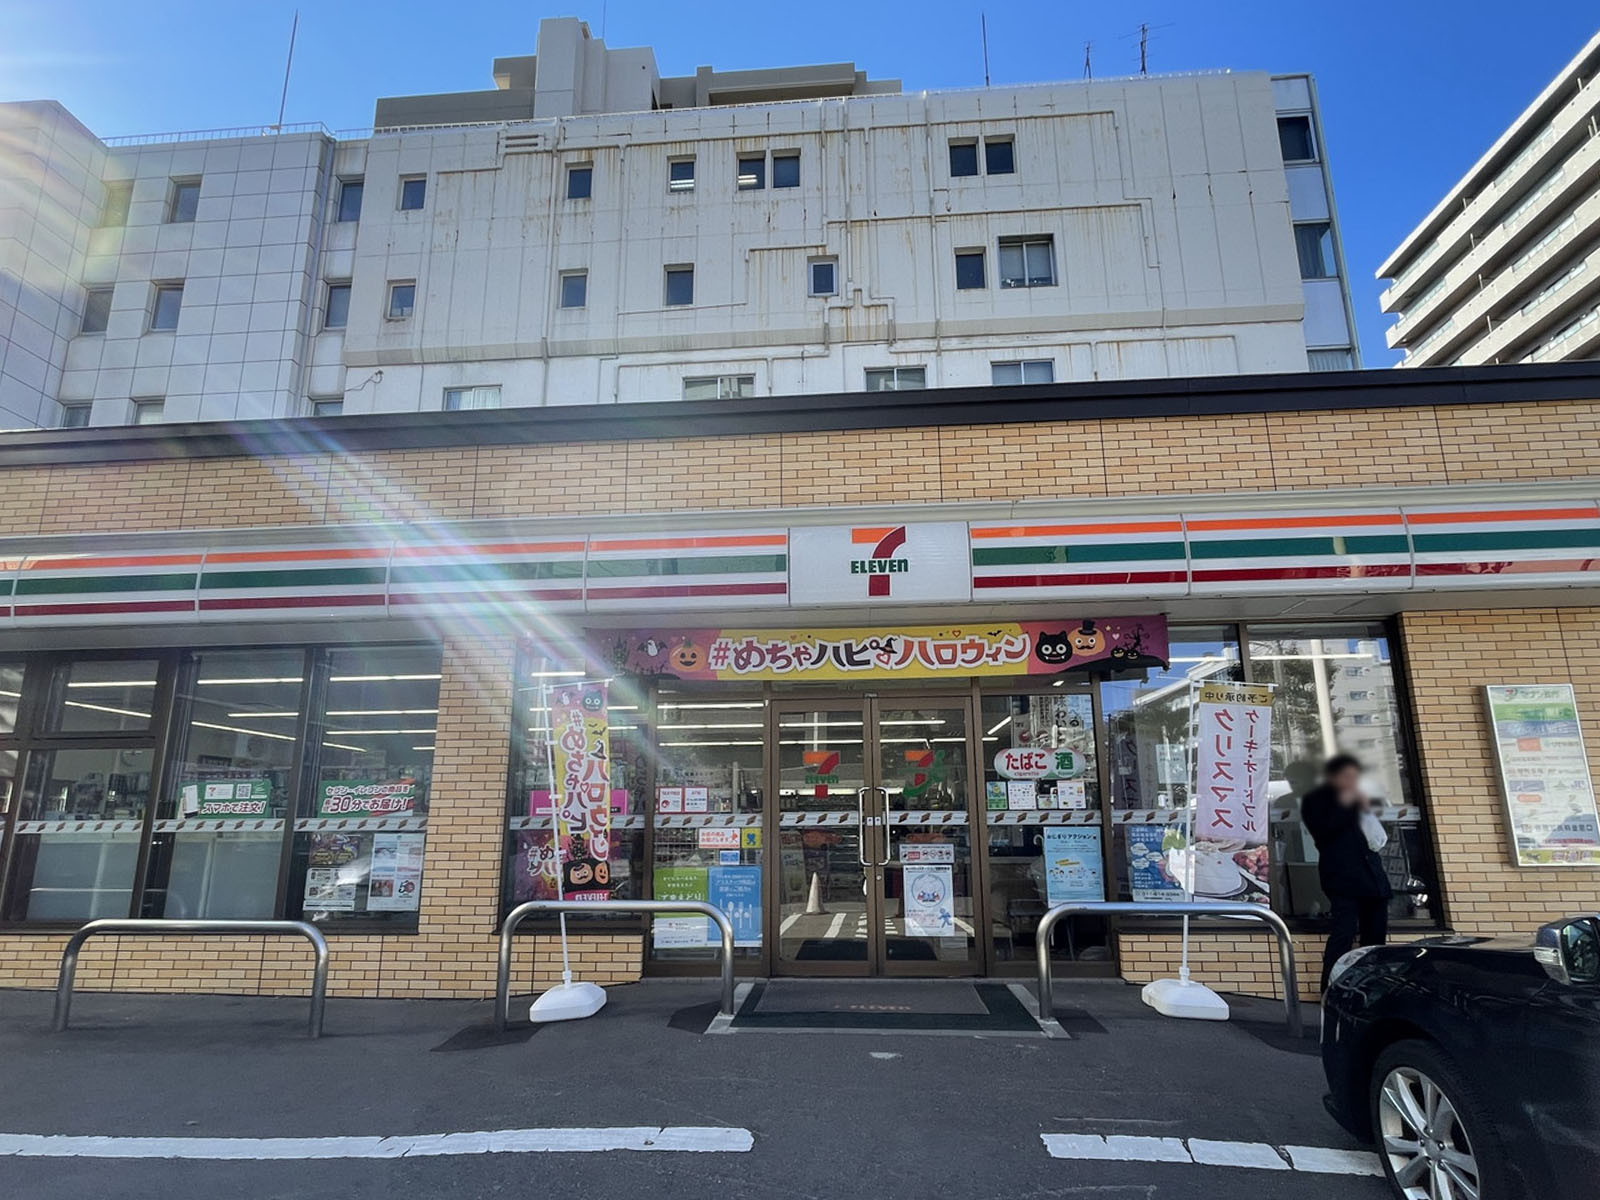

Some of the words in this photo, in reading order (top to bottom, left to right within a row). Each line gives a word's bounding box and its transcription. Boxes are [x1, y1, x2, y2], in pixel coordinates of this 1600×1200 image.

[1005, 752, 1047, 770] たばこ
[1055, 752, 1073, 770] 酒
